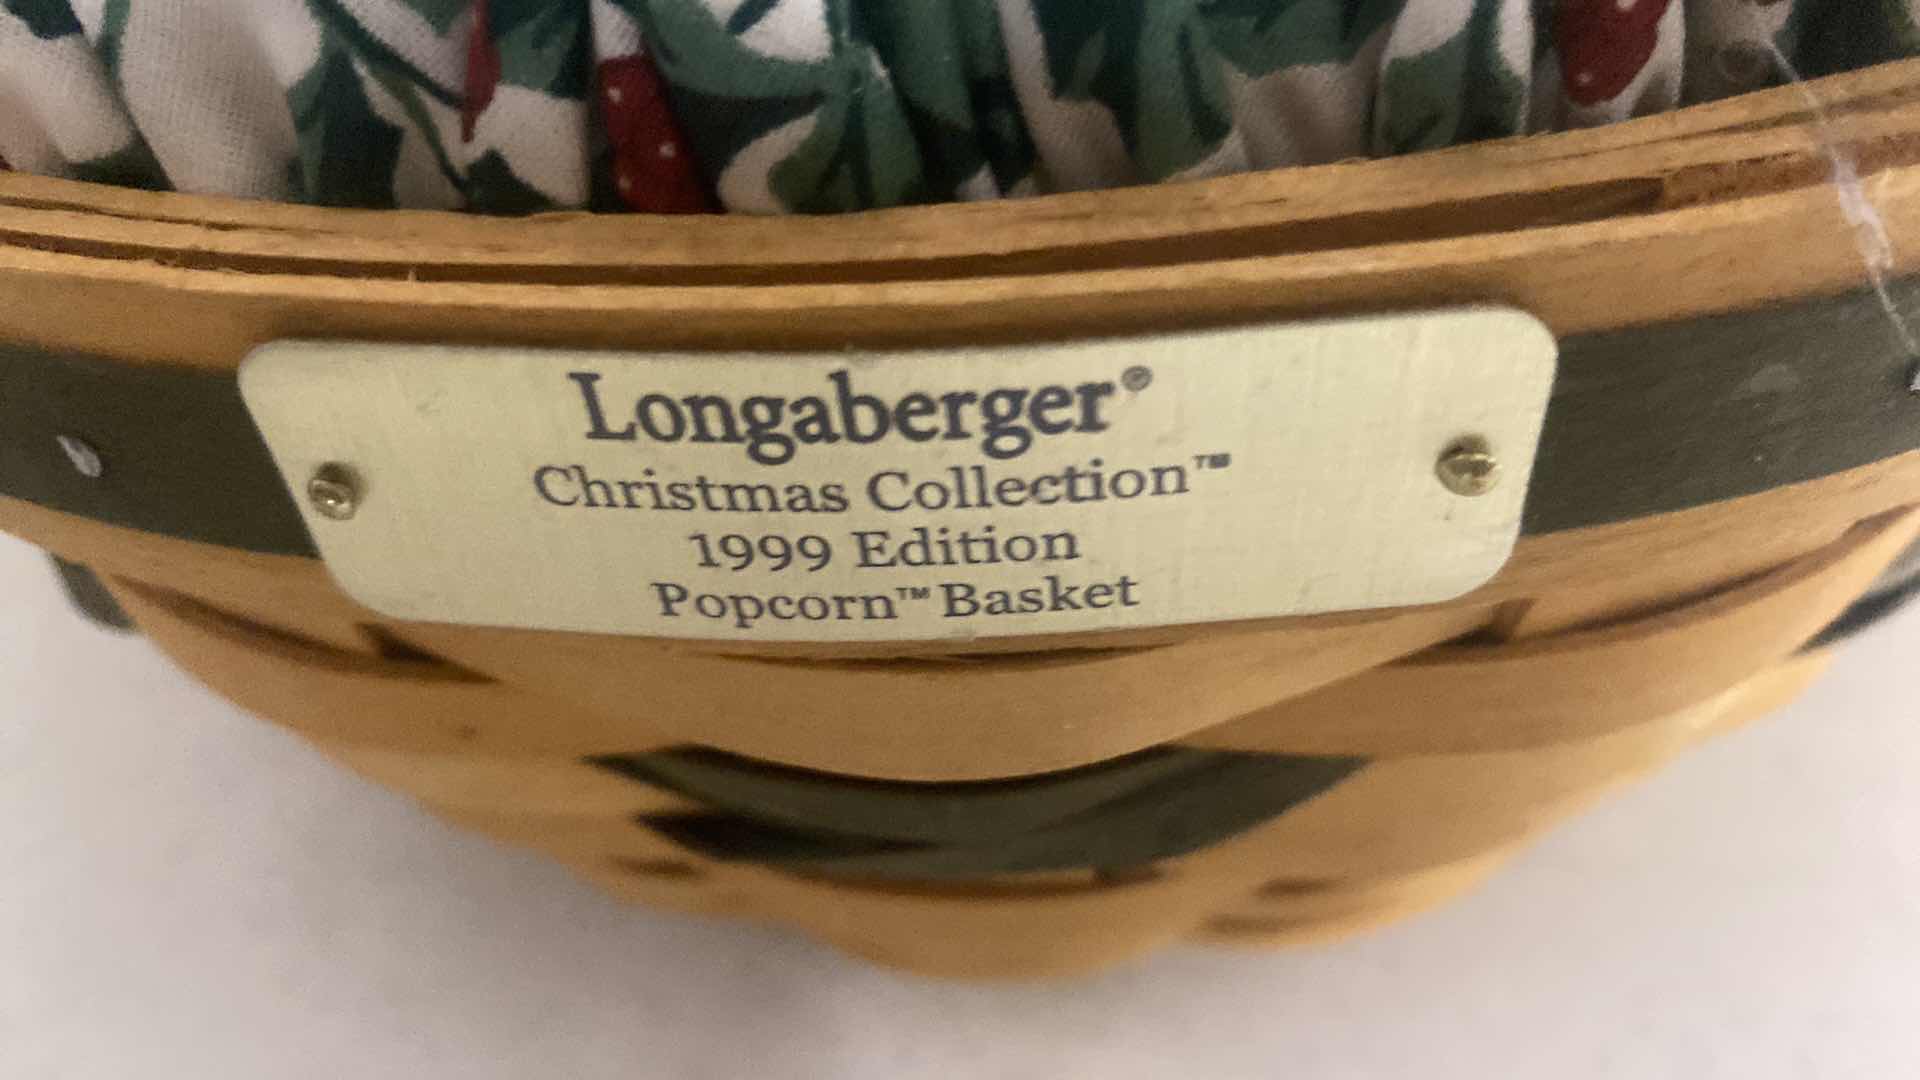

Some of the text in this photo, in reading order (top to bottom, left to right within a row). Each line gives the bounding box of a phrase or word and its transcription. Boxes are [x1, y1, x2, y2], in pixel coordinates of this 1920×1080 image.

[533, 463, 851, 514] Christmas
[688, 524, 1083, 573] 1999 Edition
[937, 574, 1141, 618] Basket
